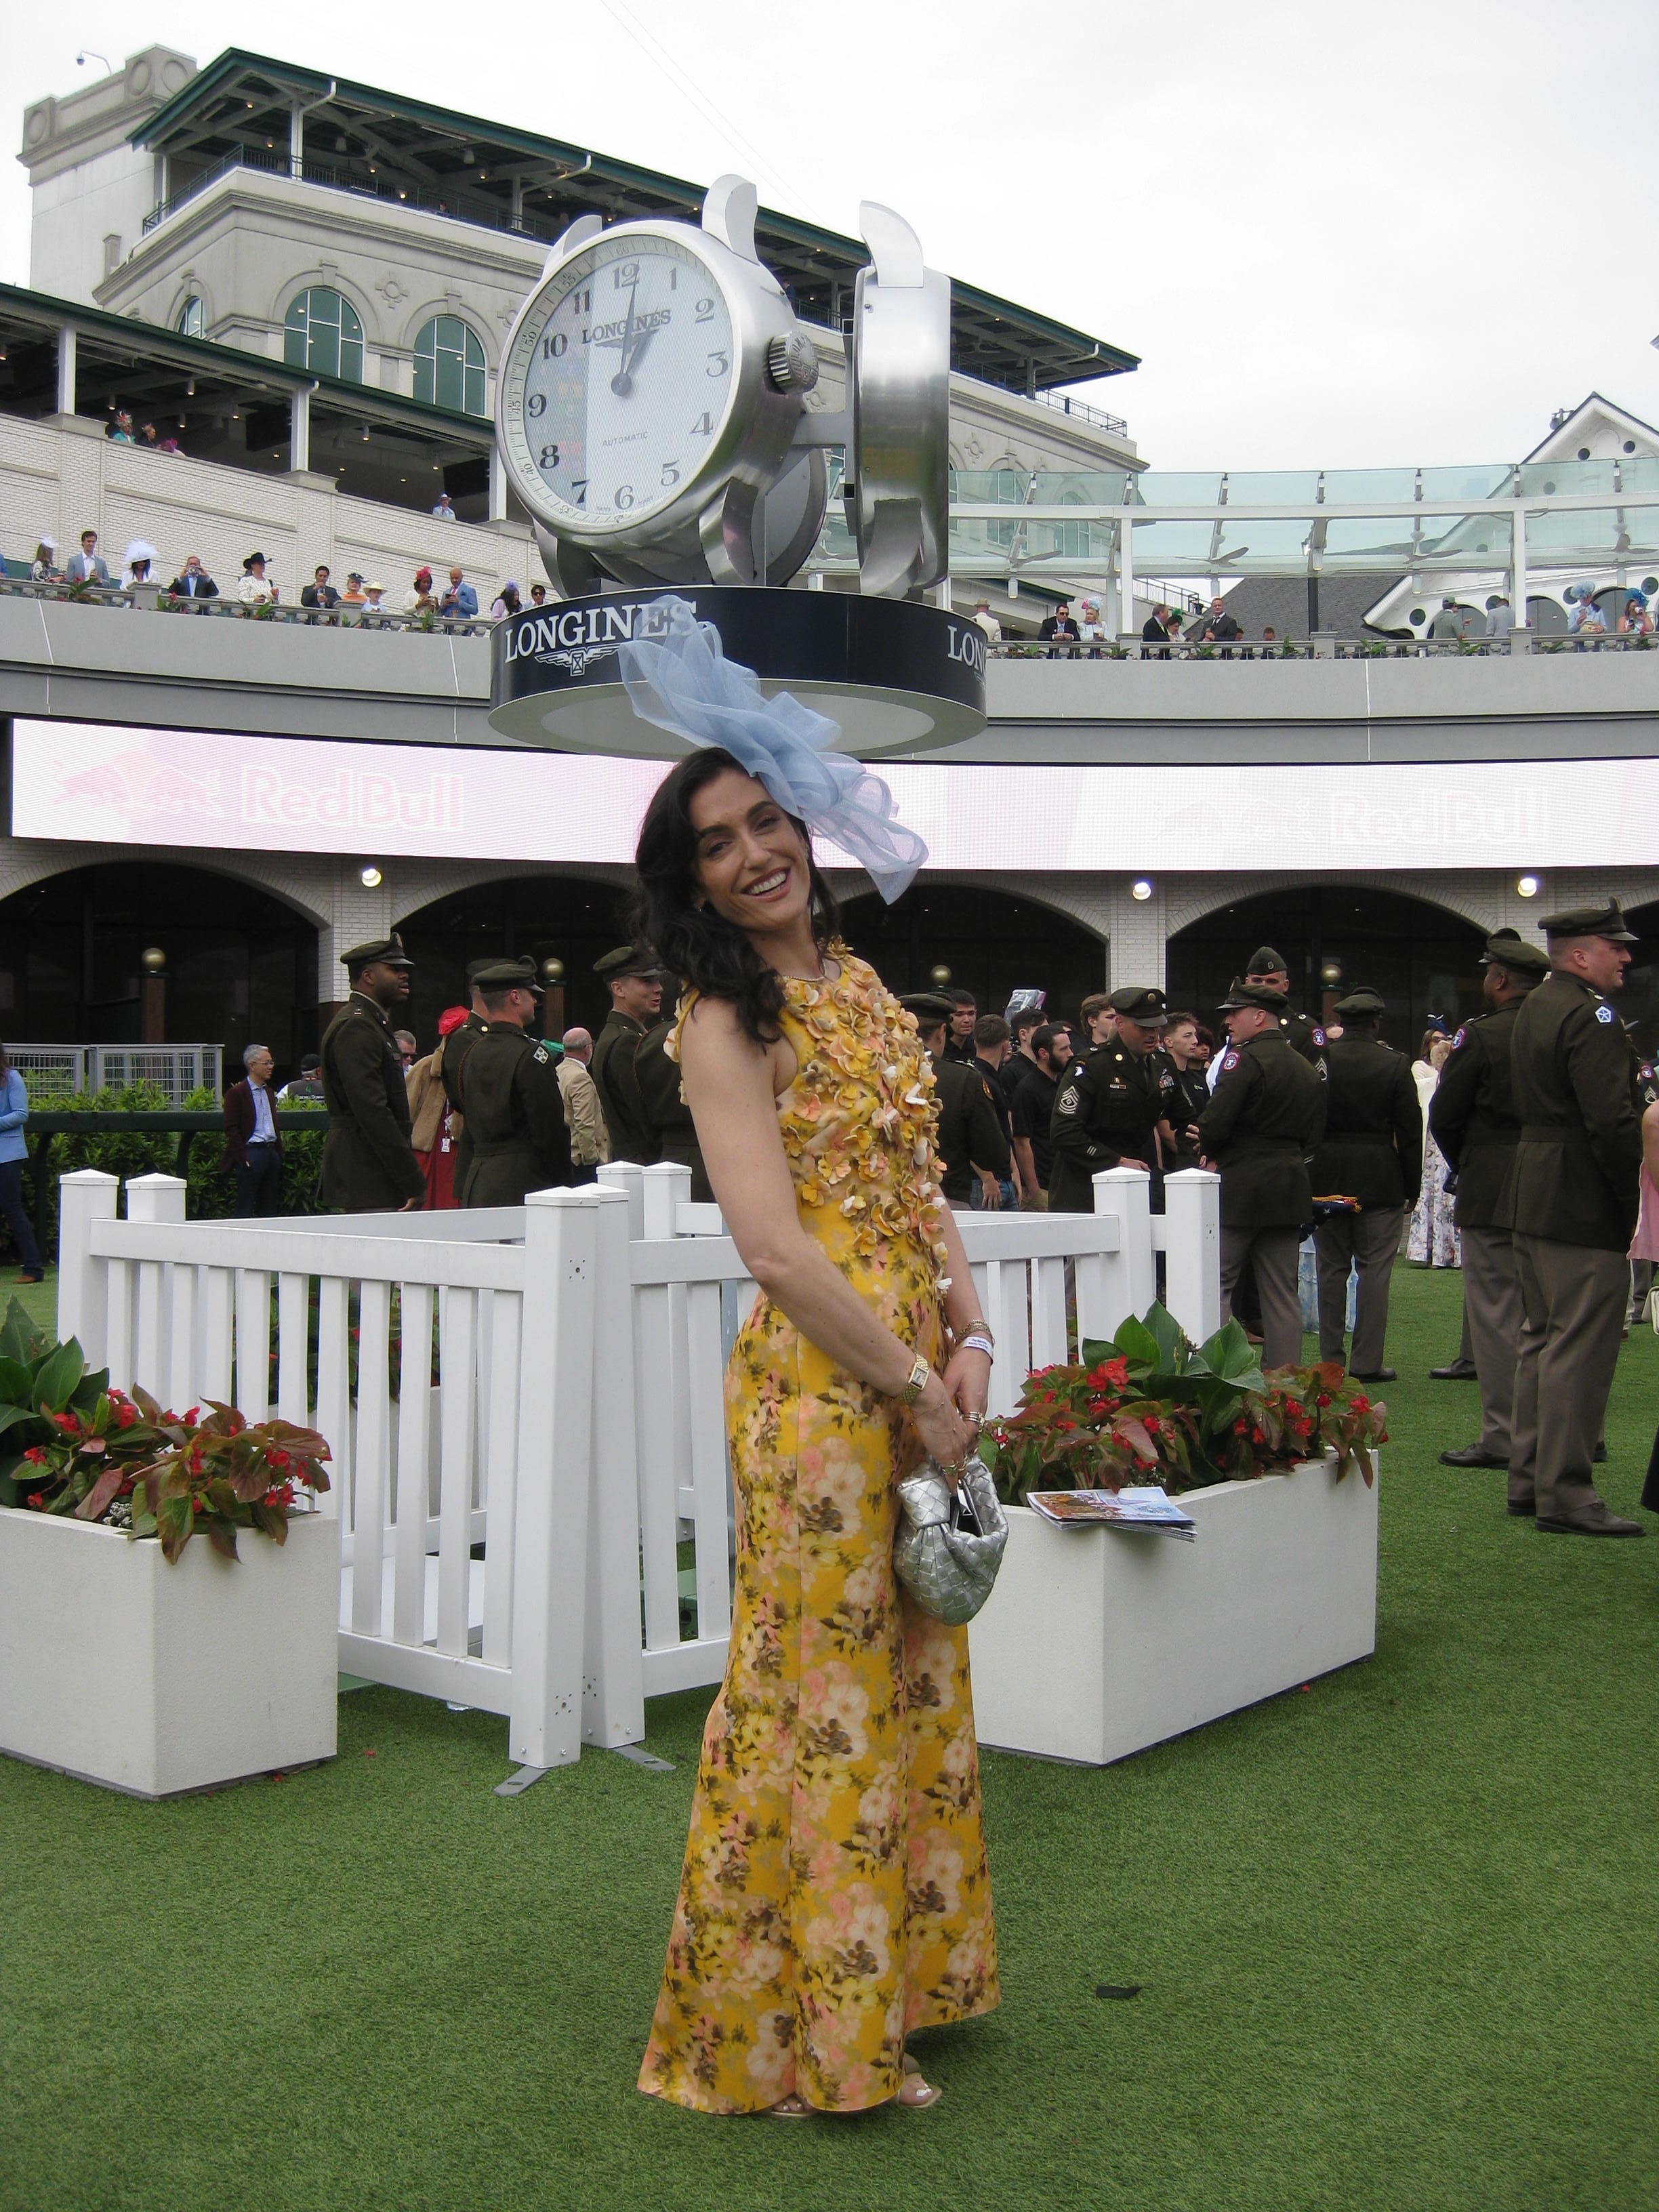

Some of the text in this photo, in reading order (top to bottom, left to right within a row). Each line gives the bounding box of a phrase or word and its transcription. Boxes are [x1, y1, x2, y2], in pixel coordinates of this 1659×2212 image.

[612, 263, 640, 289] 12
[669, 267, 677, 291] 1
[573, 289, 590, 315] 11
[695, 298, 715, 324] 2
[525, 331, 537, 347] 50
[543, 333, 568, 360] 10
[706, 350, 729, 377] 3
[528, 394, 547, 418] 9
[690, 411, 714, 436] 4
[602, 431, 649, 447] AUTOMATIC
[539, 445, 560, 470] 8
[660, 459, 680, 487] 5
[571, 479, 591, 504] 7
[614, 485, 634, 510] 6
